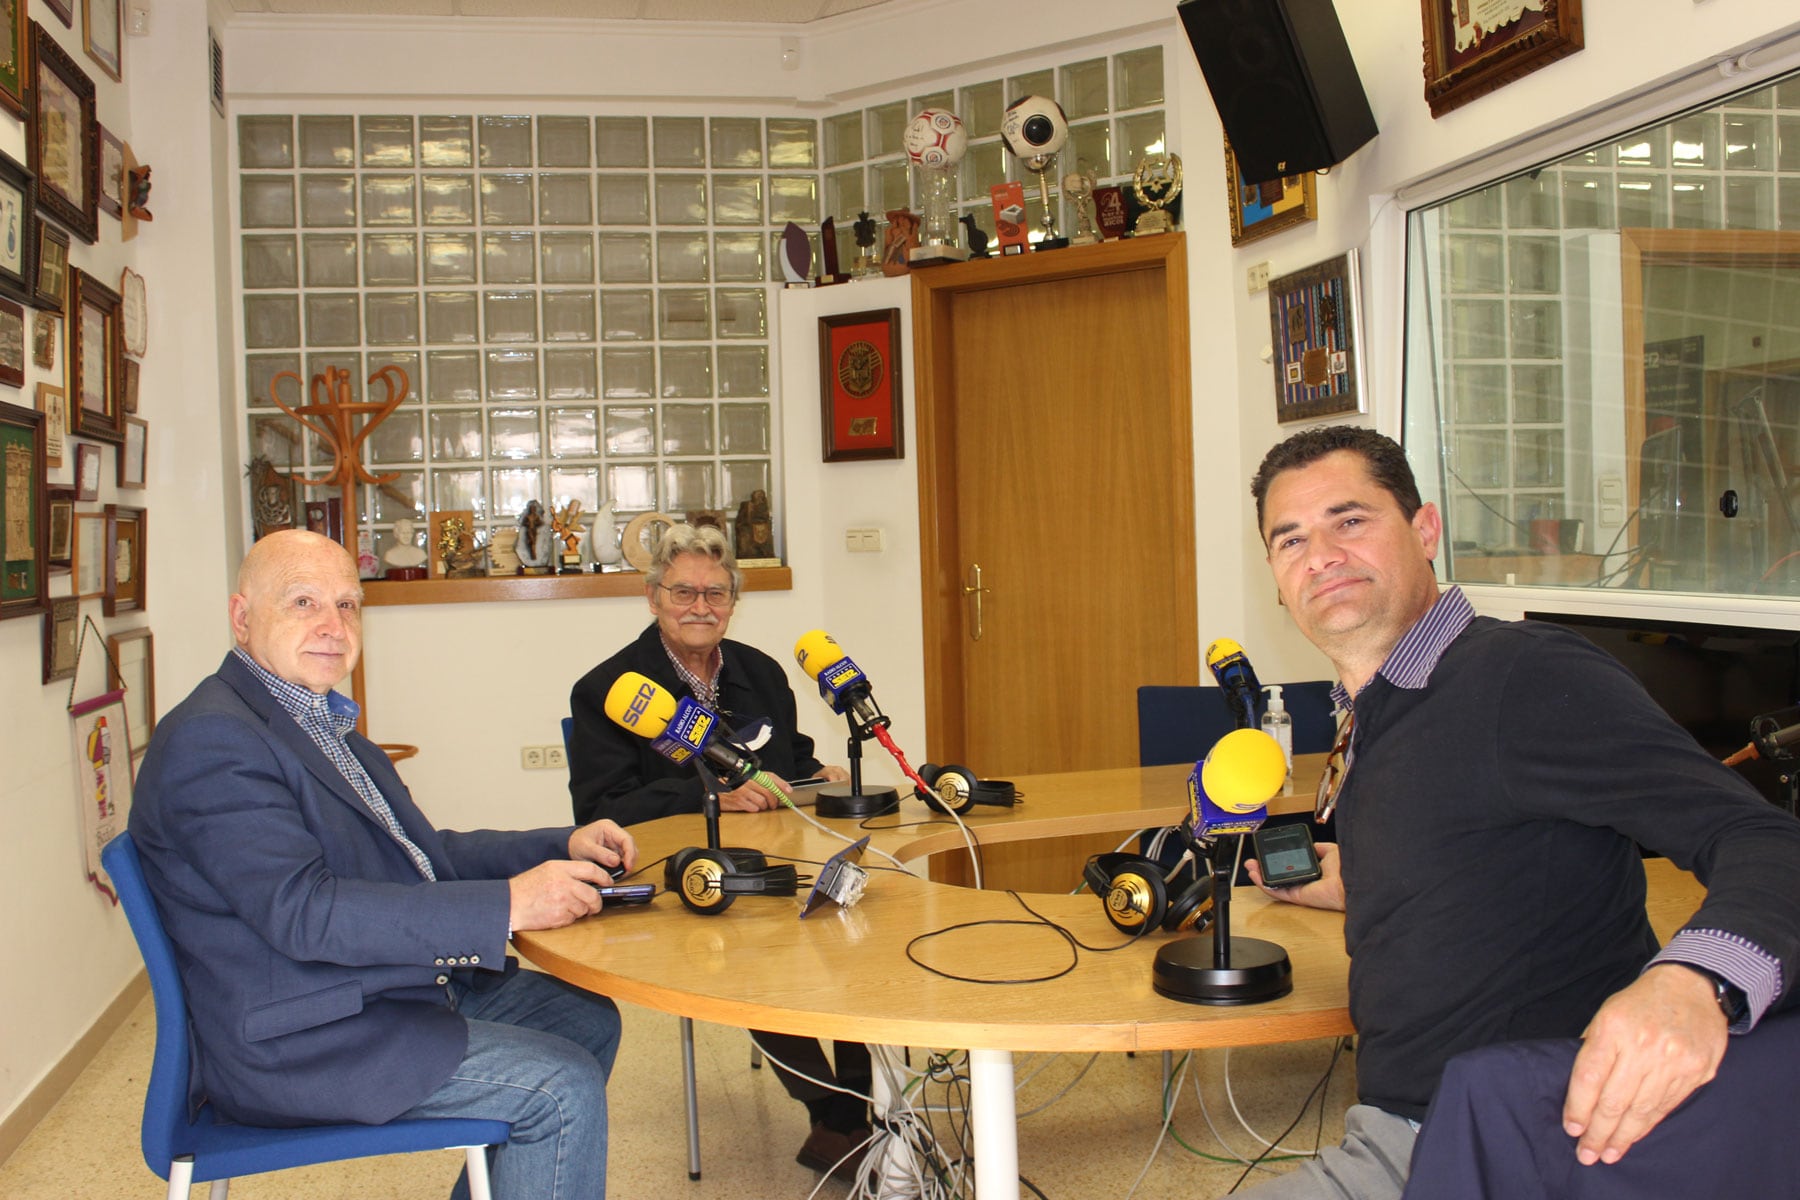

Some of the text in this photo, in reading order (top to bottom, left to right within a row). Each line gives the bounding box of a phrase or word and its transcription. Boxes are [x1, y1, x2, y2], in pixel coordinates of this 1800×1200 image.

[622, 683, 656, 727] SER
[675, 704, 693, 734] RADIO ALCOY
[683, 710, 701, 740] CADENA
[688, 714, 711, 746] SER
